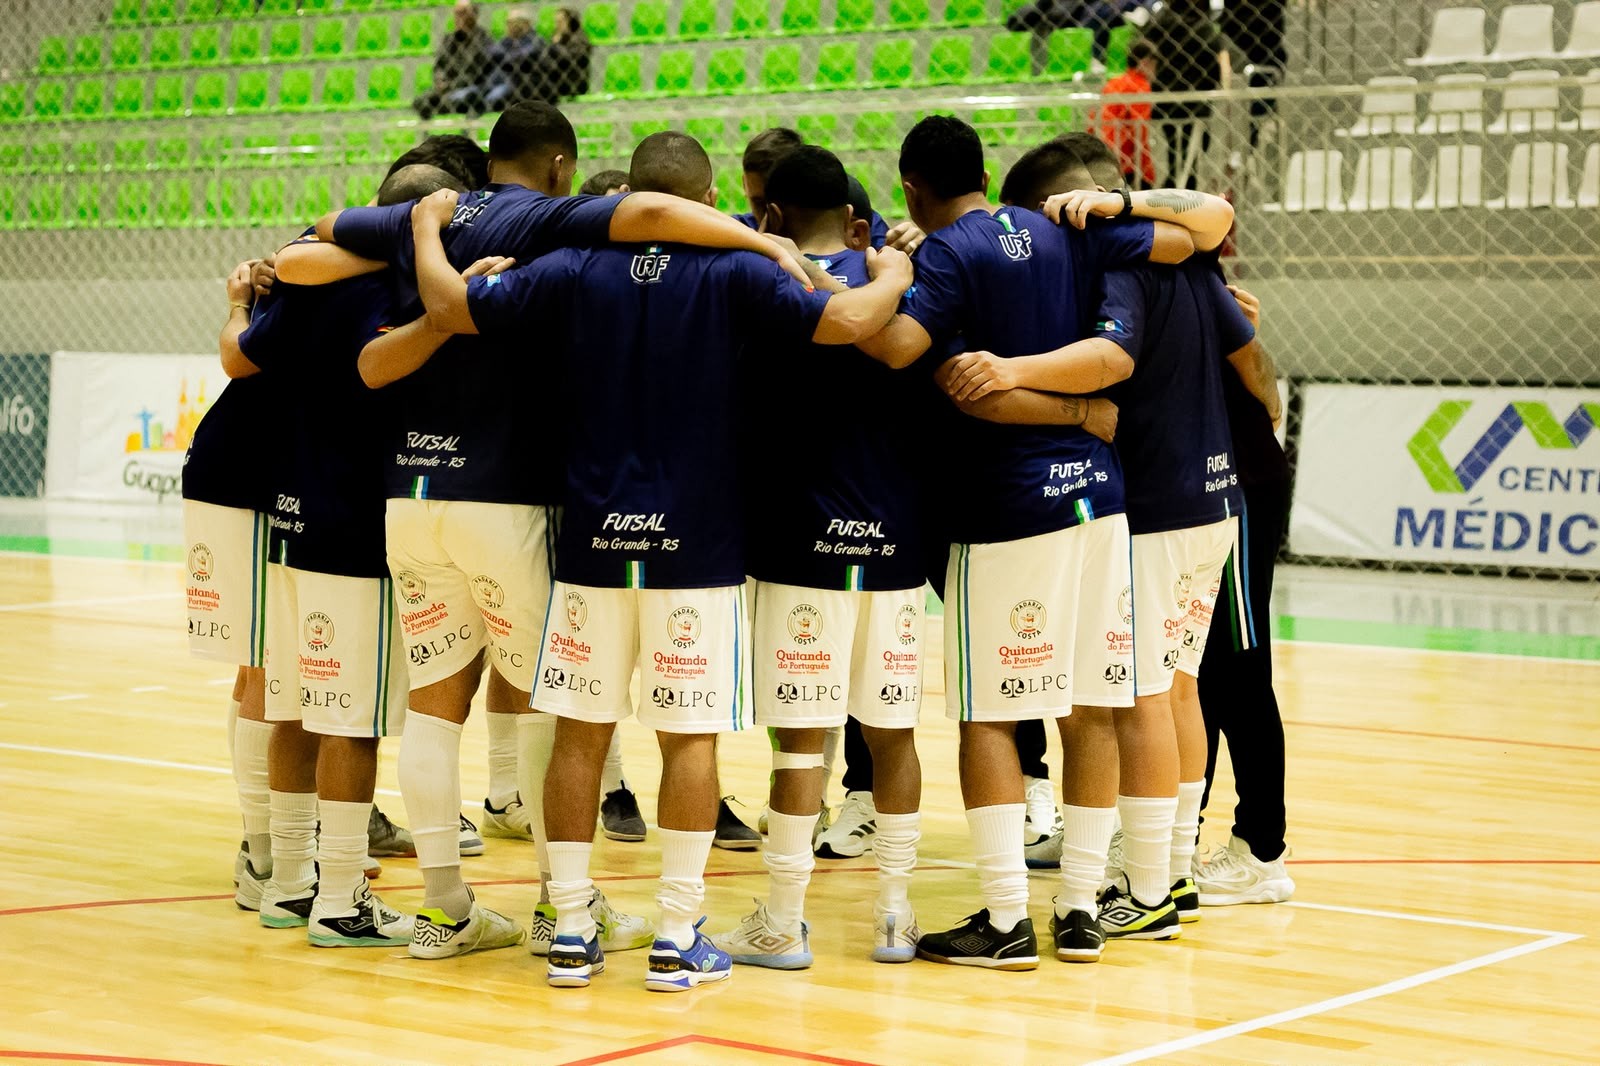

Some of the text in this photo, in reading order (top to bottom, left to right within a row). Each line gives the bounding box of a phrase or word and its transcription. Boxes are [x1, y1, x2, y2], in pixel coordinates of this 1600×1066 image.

[407, 431, 460, 451] FUTSAL
[408, 454, 440, 467] Grande
[448, 457, 467, 468] RS
[1043, 485, 1060, 498] Rio
[1094, 471, 1109, 483] RS
[1497, 466, 1600, 493] CENT
[293, 521, 305, 534] RS
[602, 512, 666, 532] FUTSAL
[826, 518, 885, 538] FUTSAL
[1393, 496, 1600, 556] MÉDIC
[591, 537, 609, 550] Rio
[610, 537, 650, 550] Grande
[661, 539, 679, 551] RS
[813, 540, 831, 554] Rio
[833, 543, 872, 556] Grande
[880, 544, 896, 557] RS
[673, 608, 699, 620] PADARIA
[792, 605, 818, 617] PADARIA
[1015, 601, 1042, 613] PADARIA
[1188, 609, 1197, 617] do
[410, 610, 449, 631] Português
[197, 620, 231, 640] LPC
[1017, 629, 1042, 640] COSTA
[307, 642, 329, 652] COSTA
[430, 624, 472, 657] LPC
[672, 638, 696, 649] COSTA
[793, 635, 818, 646] COSTA
[1107, 643, 1118, 651] do
[549, 645, 559, 653] do
[776, 649, 831, 663] Quitanda
[999, 642, 1054, 658] Quitanda
[654, 651, 708, 666] Quitanda
[1001, 653, 1053, 665] do Português
[304, 667, 339, 679] Português
[654, 664, 665, 673] do
[666, 665, 706, 677] Português
[777, 662, 829, 671] do Português
[884, 662, 894, 670] do
[567, 674, 602, 696] LPC
[1028, 674, 1068, 694] LPC
[313, 688, 352, 709] LPC
[678, 691, 717, 708] LPC
[801, 685, 841, 701] LPC
